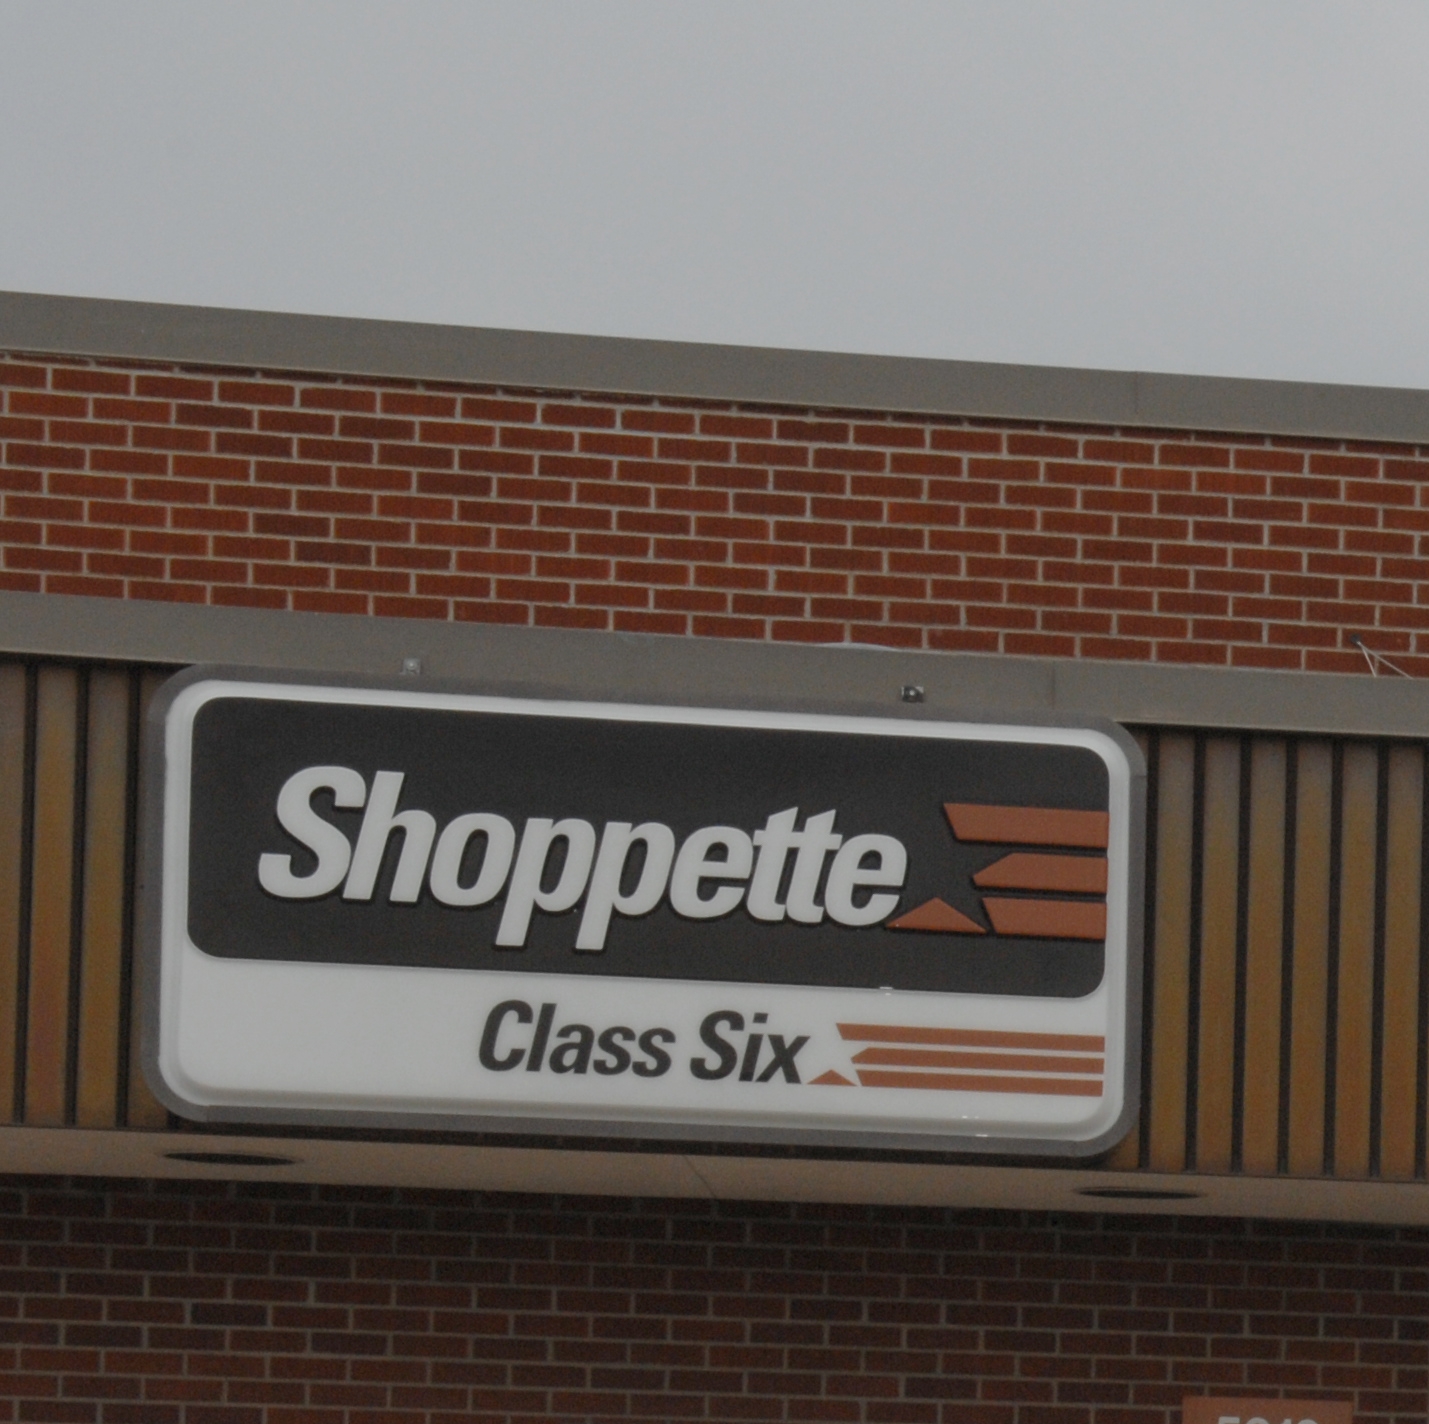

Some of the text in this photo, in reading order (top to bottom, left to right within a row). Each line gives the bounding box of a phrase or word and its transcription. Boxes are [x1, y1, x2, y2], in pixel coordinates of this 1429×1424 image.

[257, 765, 908, 951] Shoppette
[477, 1000, 812, 1085] Class Six
